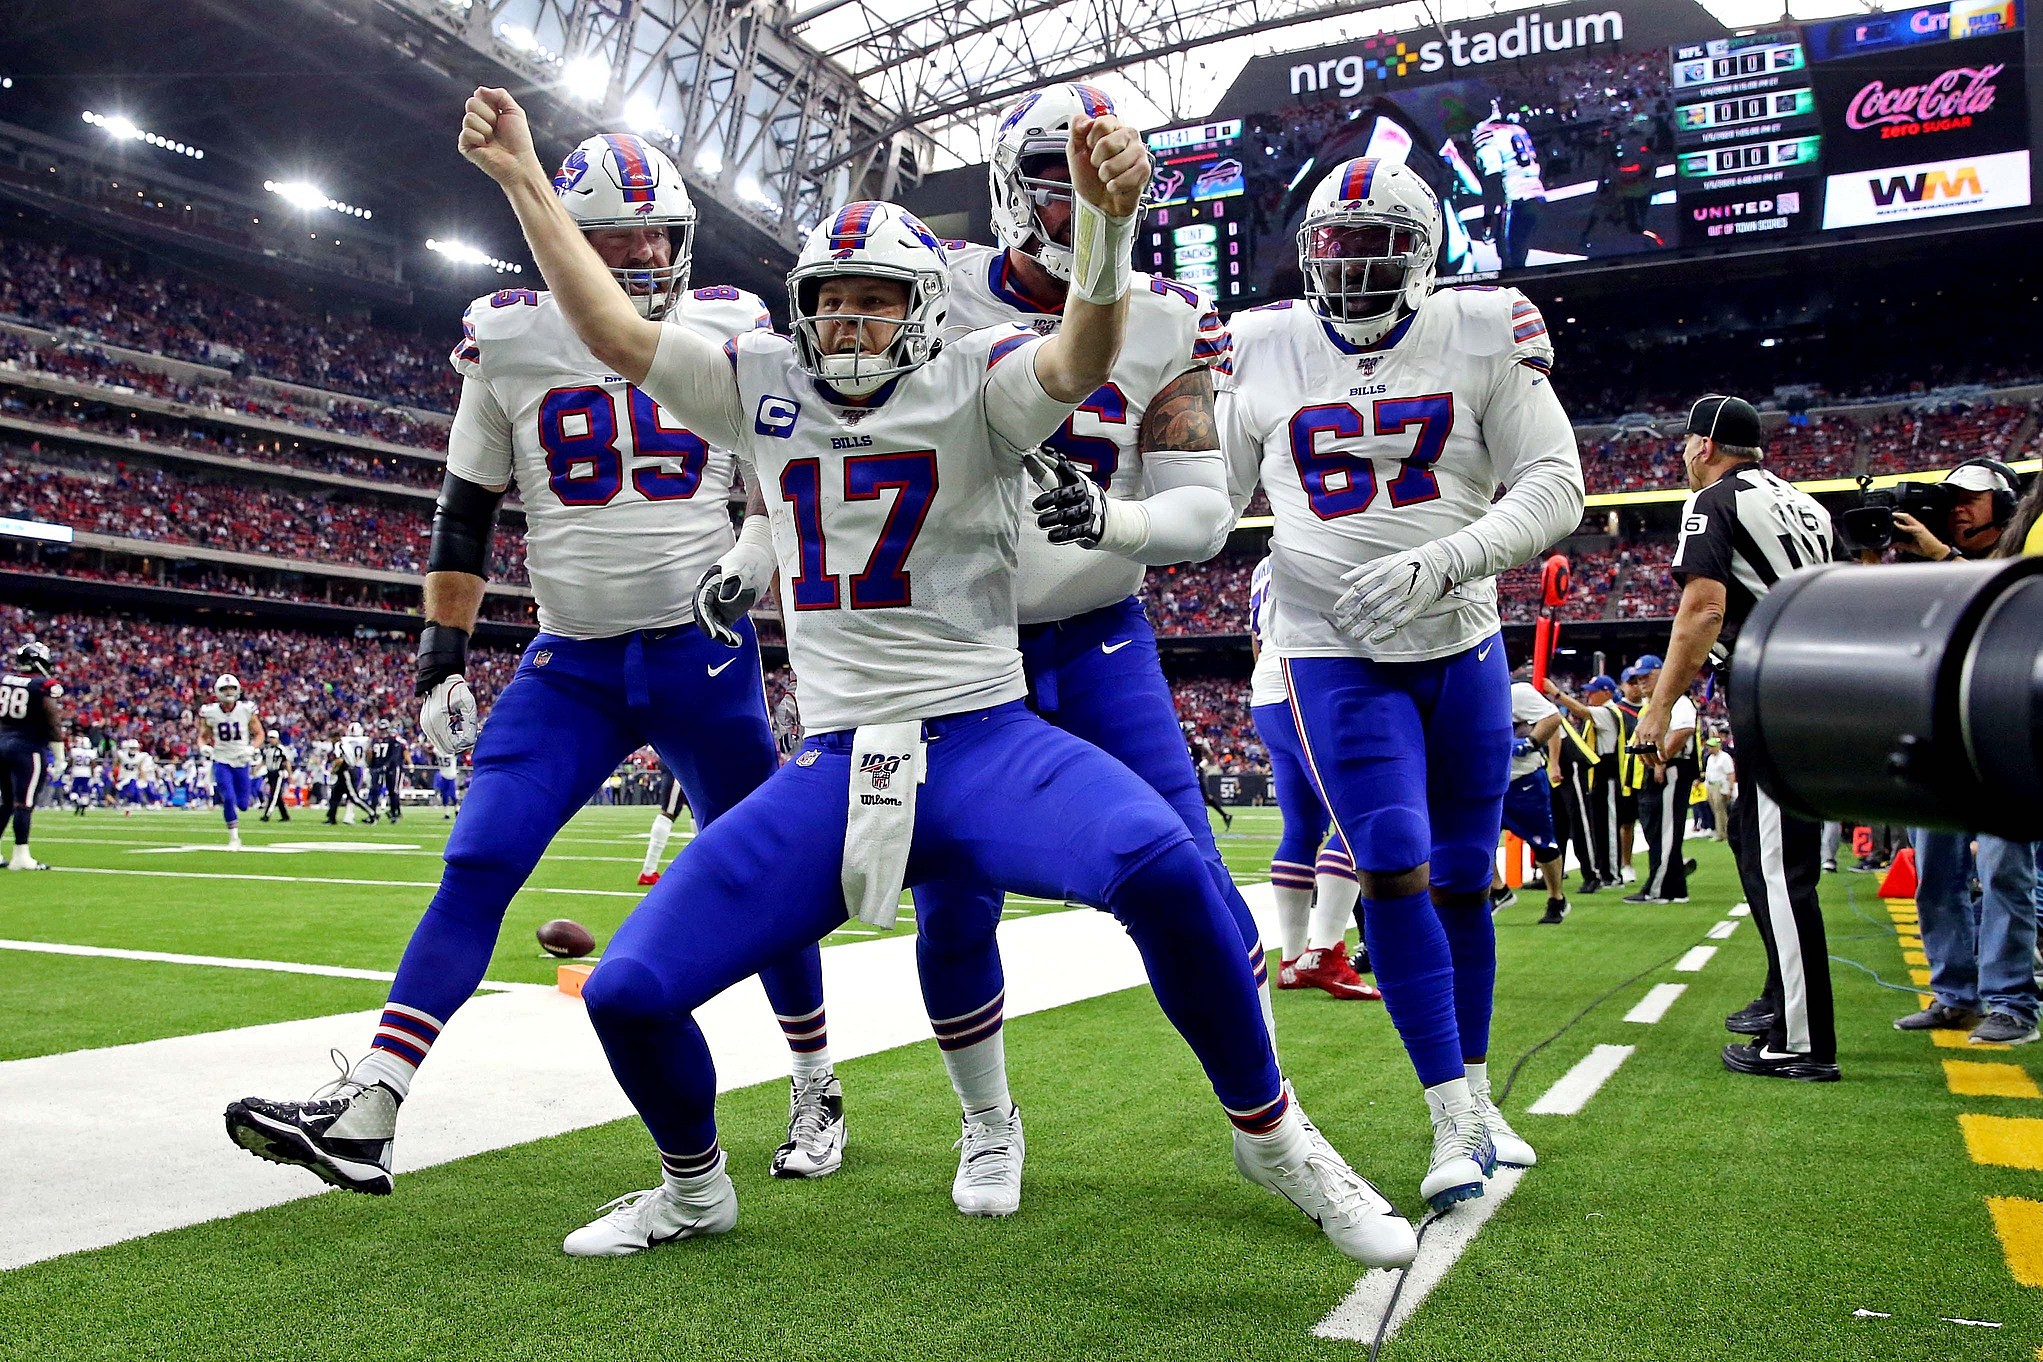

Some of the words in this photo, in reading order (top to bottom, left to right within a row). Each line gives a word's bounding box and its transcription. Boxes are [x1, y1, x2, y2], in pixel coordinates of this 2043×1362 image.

[1290, 56, 1364, 97] nrg
[1420, 9, 1625, 73] stadium
[1845, 63, 2005, 130] Coca-Cola
[1922, 115, 1972, 133] SUGAR
[1160, 130, 1189, 146] 11:41
[1869, 166, 1982, 206] WM
[1693, 200, 1773, 221] UNITED
[1735, 220, 1757, 233] TOWN
[1179, 247, 1213, 261] SACKS
[1349, 384, 1387, 396] BILLS
[759, 398, 796, 428] C
[538, 382, 710, 506] 85
[831, 435, 873, 449] BILLS
[1288, 391, 1454, 521] 67
[779, 449, 940, 611] 17
[0, 685, 30, 719] 98
[218, 722, 242, 741] 81
[874, 778, 888, 788] NFL
[860, 794, 902, 806] Wilson
